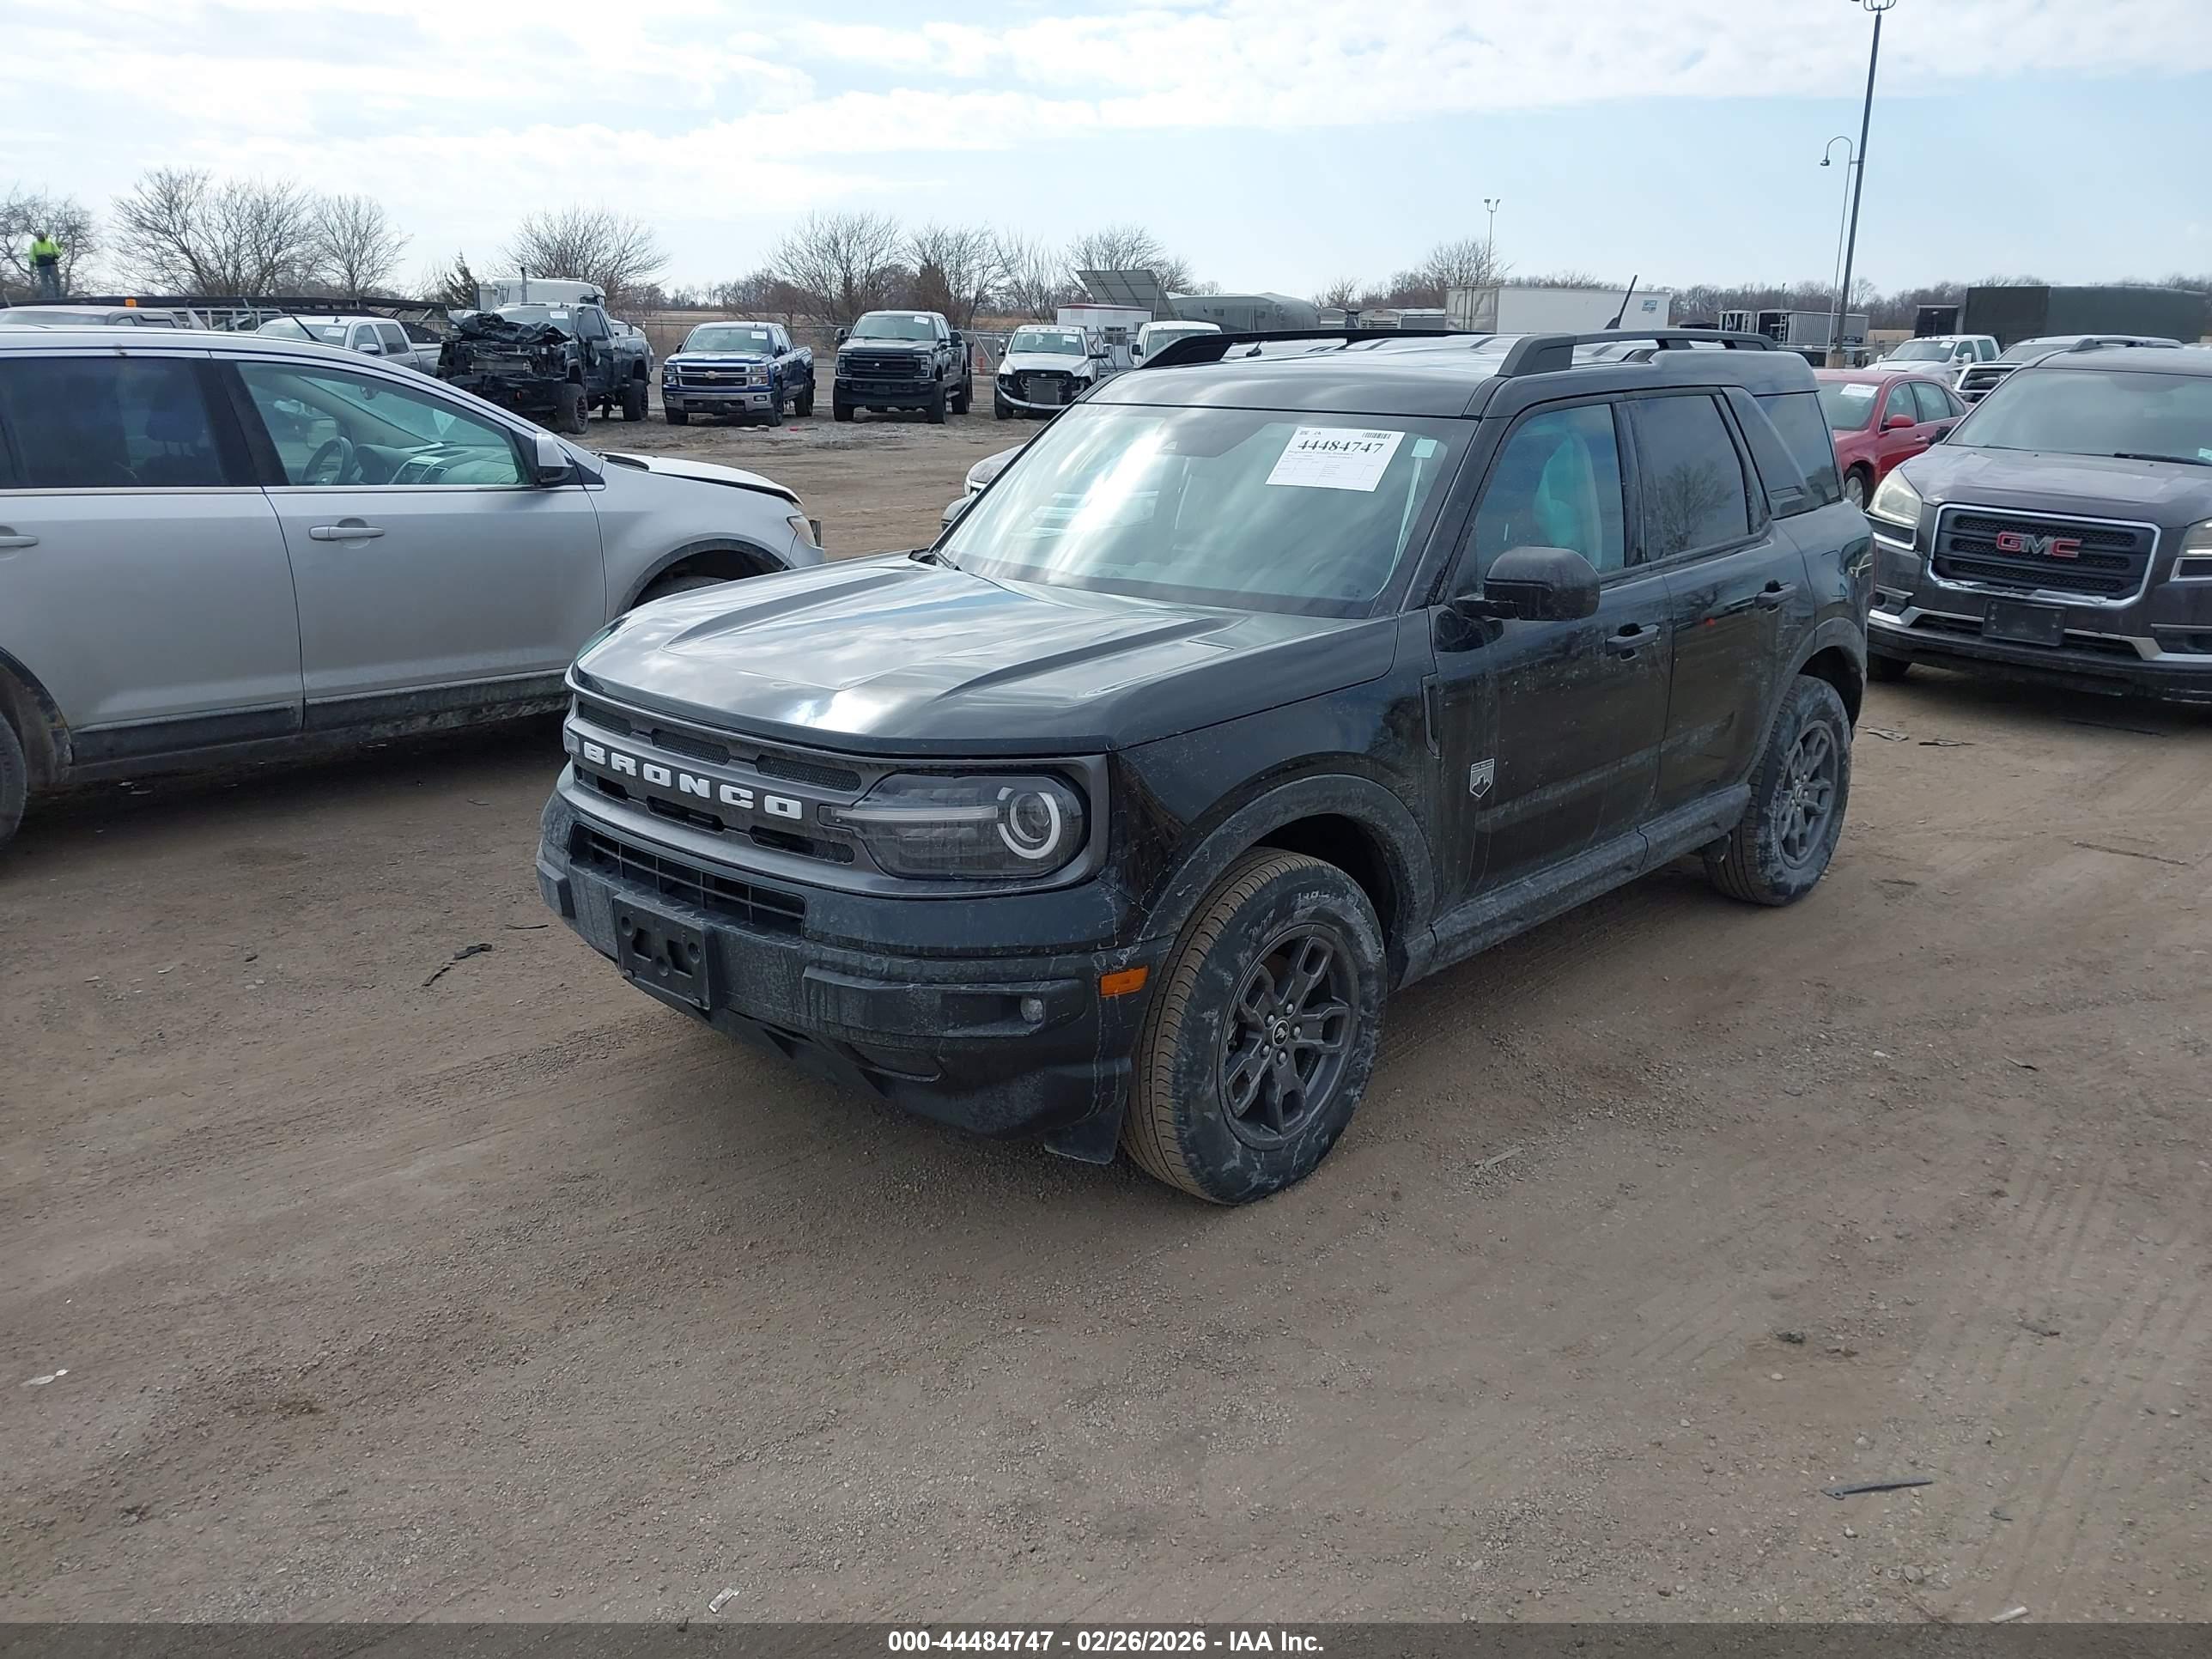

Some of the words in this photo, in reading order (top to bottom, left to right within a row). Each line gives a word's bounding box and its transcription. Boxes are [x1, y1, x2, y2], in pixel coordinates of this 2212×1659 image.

[1297, 440, 1384, 453] 44484747
[1996, 532, 2081, 557] GMC
[583, 740, 803, 820] BRONCO
